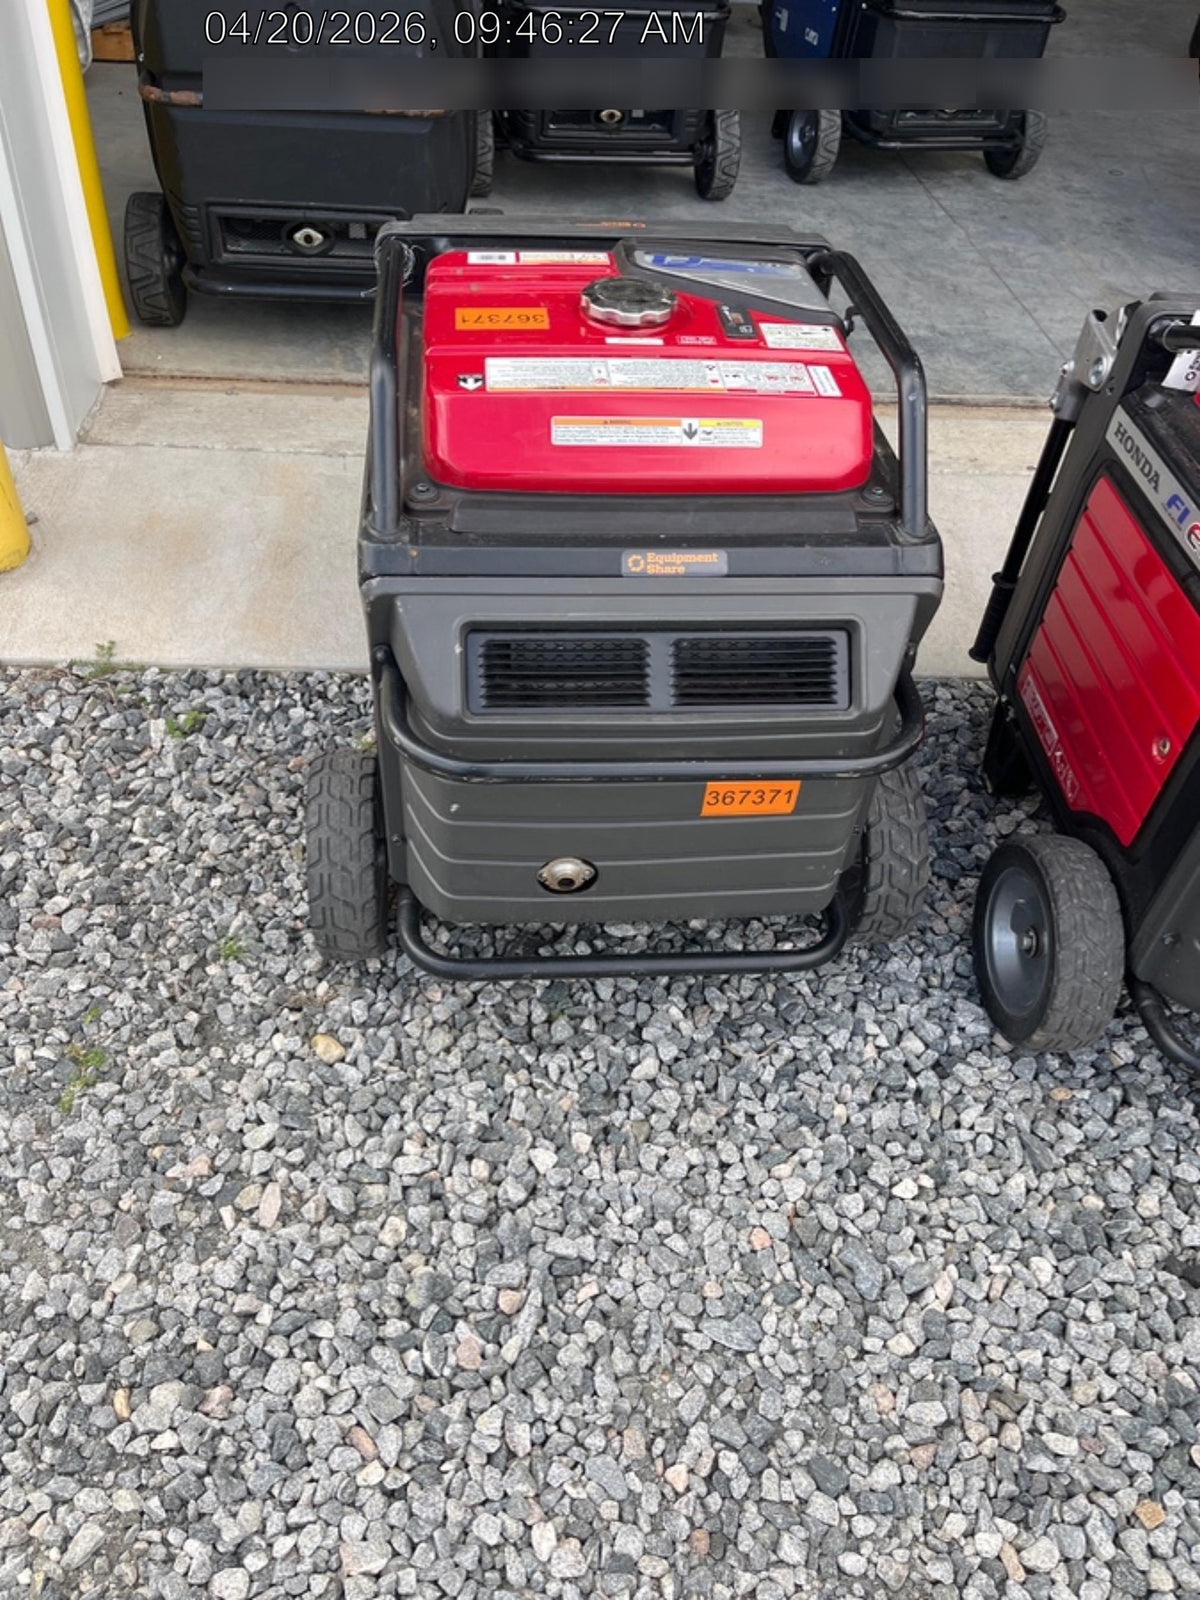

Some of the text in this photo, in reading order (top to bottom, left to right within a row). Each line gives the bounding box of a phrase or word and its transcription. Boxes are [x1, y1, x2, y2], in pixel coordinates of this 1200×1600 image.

[461, 314, 544, 324] 367371
[1114, 421, 1160, 494] HONDA
[646, 551, 719, 564] Equipment
[646, 562, 686, 576] Share
[706, 787, 794, 807] 367371
